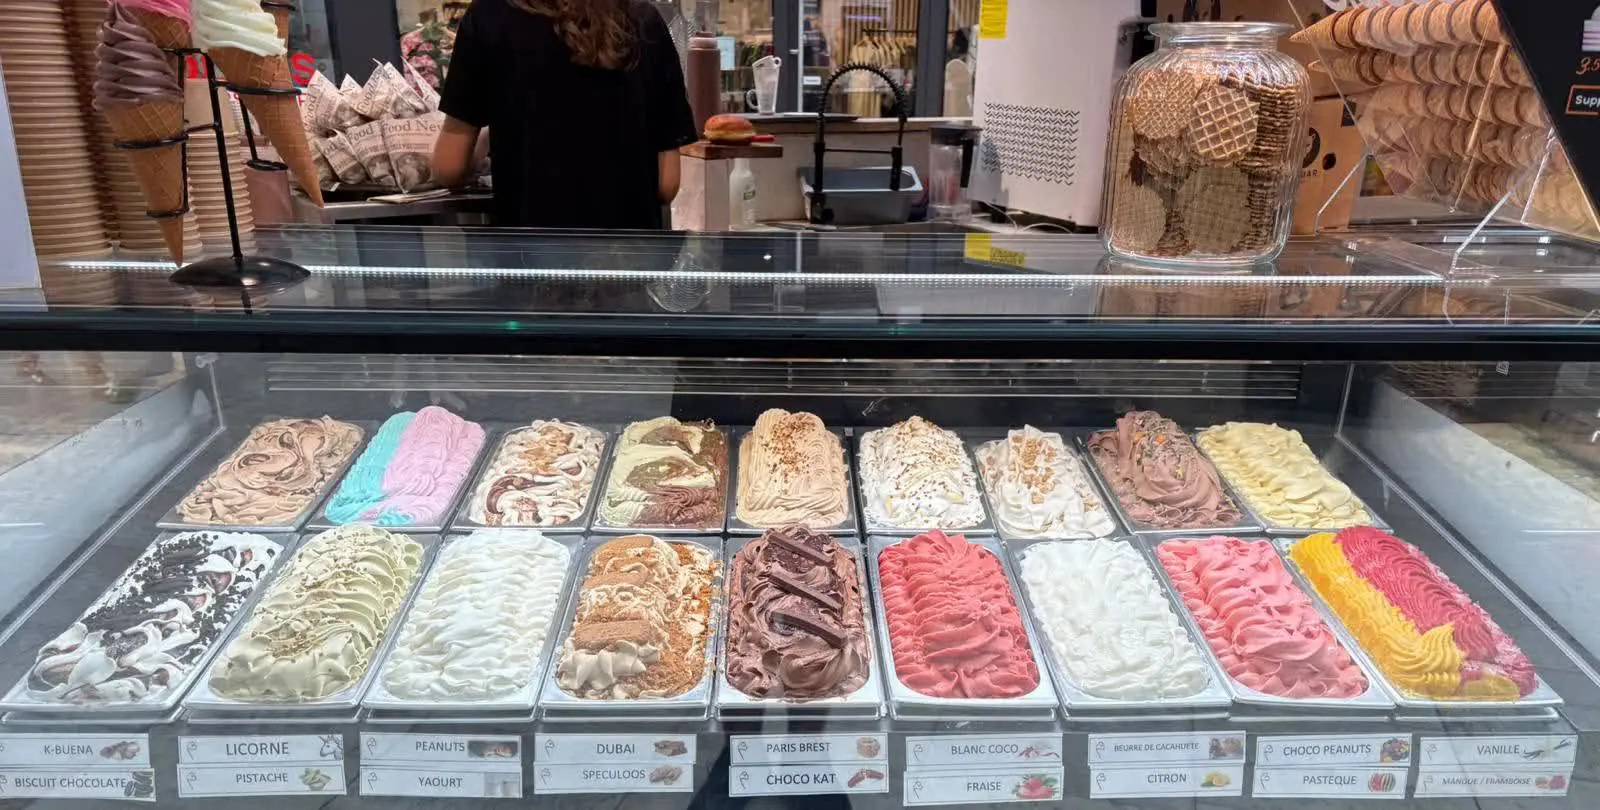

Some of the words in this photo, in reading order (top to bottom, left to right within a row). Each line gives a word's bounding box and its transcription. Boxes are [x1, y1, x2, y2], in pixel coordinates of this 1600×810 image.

[43, 744, 93, 755] K-BUENA
[226, 741, 289, 756] LICORNE
[415, 741, 465, 752] PEANUTS
[596, 743, 635, 754] DUBAI
[766, 743, 796, 753] PARIS
[799, 742, 831, 752] BREST
[951, 745, 985, 755] BLANC
[988, 744, 1019, 754] COCO
[1114, 744, 1142, 752] BEURRE
[1283, 746, 1321, 756] CHOCO
[1323, 744, 1371, 755] PEANUTS
[1477, 744, 1520, 755] VANILLE
[236, 773, 288, 783] PISTACHE
[583, 770, 646, 780] SPECULOOS
[766, 774, 810, 785] CHOCO
[813, 773, 836, 784] KAT
[1147, 773, 1187, 784] CITRON
[1303, 775, 1357, 786] PASTEQUE
[15, 777, 57, 788] BISCUIT
[59, 777, 126, 789] CHOCOLATE
[418, 777, 463, 787] YAOURT
[966, 782, 1001, 792] FRAISE
